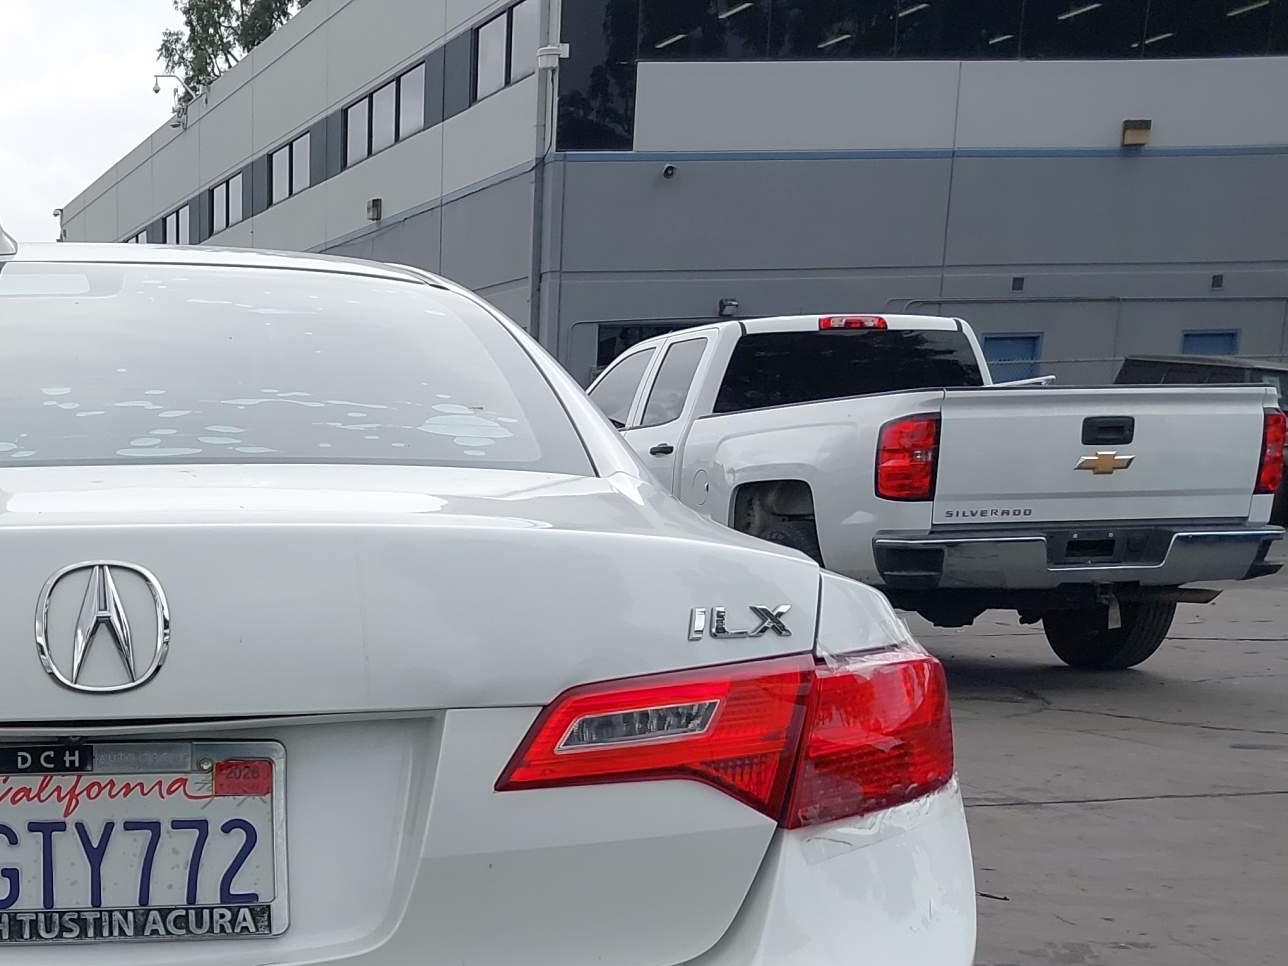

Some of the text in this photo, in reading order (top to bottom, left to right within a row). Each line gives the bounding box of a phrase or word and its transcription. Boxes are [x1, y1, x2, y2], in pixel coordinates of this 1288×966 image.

[945, 508, 1033, 518] SILVERADO
[688, 604, 792, 641] ILX
[17, 911, 134, 939] TUSTIN
[144, 908, 256, 935] ACURA
